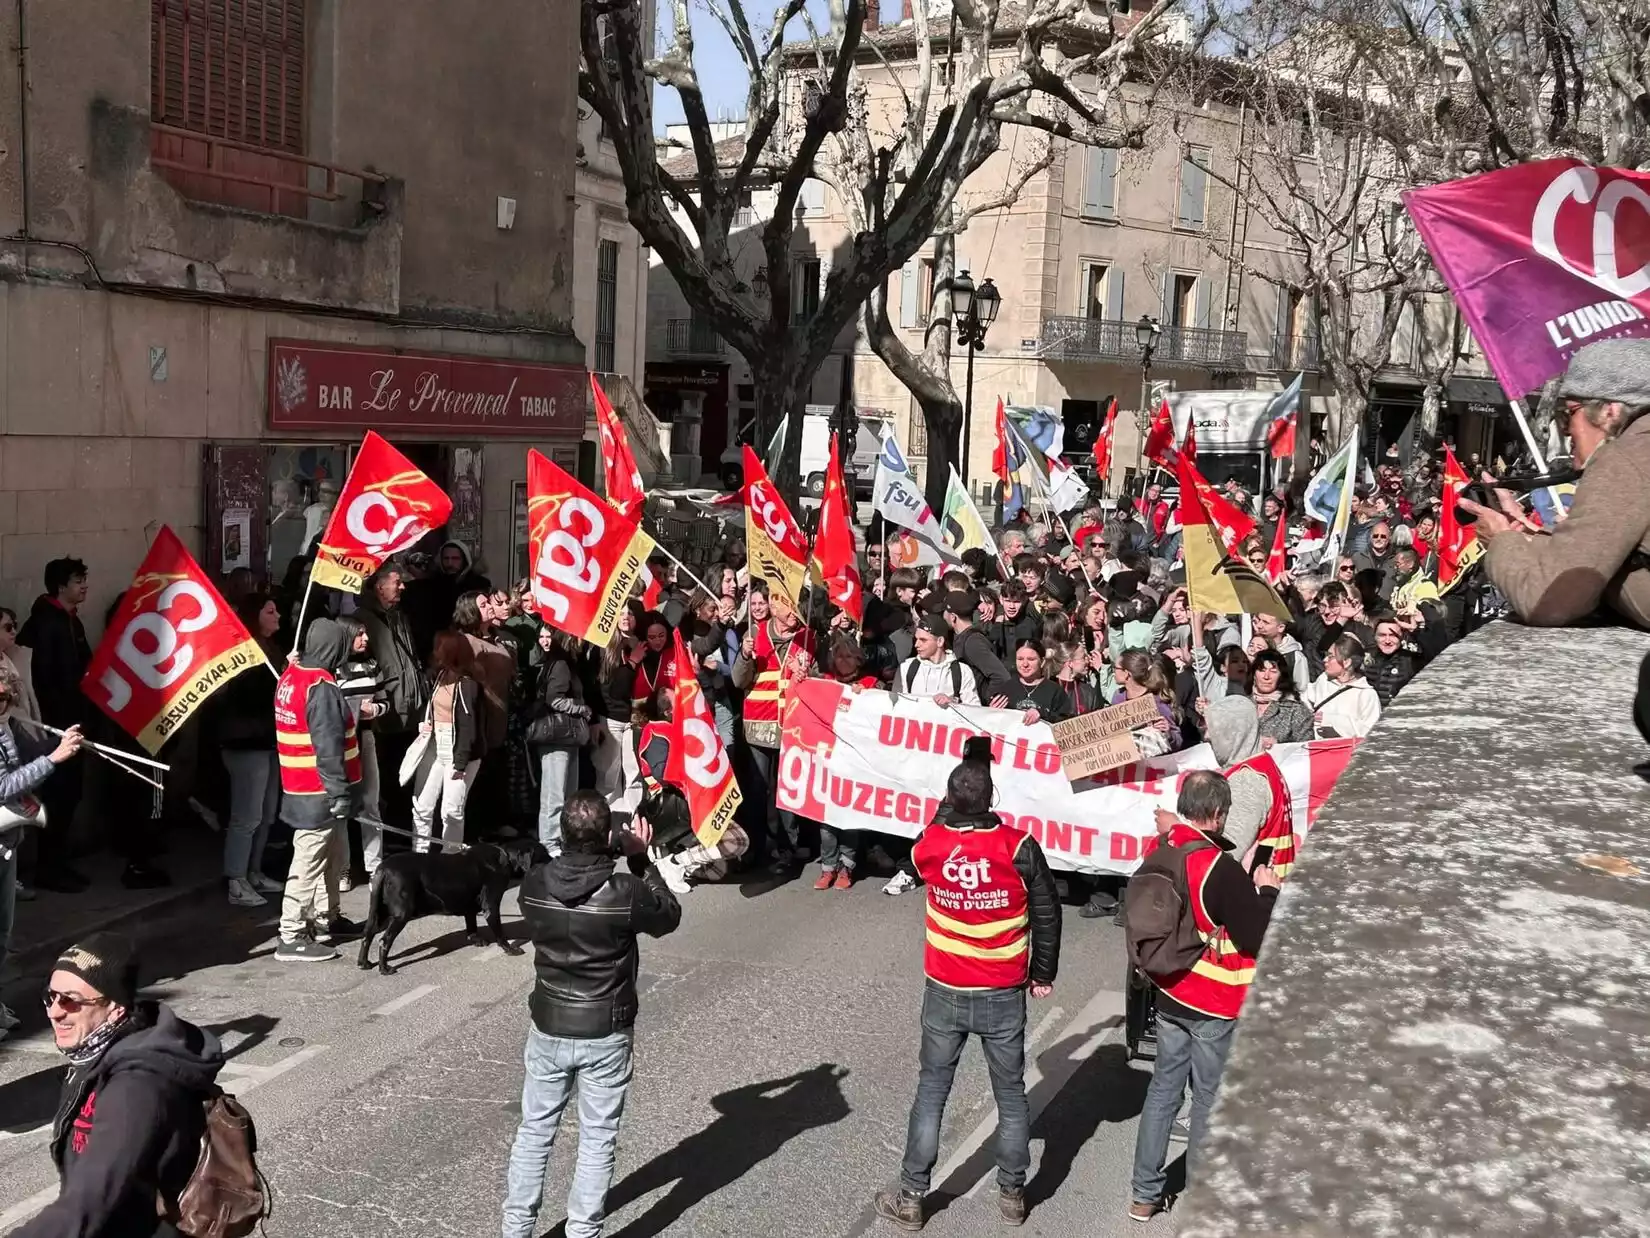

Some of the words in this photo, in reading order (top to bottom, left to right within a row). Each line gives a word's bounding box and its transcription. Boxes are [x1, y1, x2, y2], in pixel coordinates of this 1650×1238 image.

[318, 385, 353, 409] BAR
[361, 369, 401, 411] Le
[409, 371, 518, 421] Provençal
[520, 396, 556, 416] TABAC
[883, 480, 921, 511] fsu
[778, 741, 830, 809] gt
[1013, 737, 1166, 796] LOALE
[942, 857, 992, 889] cgt
[932, 885, 963, 900] Union
[967, 888, 1008, 900] Locale
[935, 896, 961, 910] PAYS
